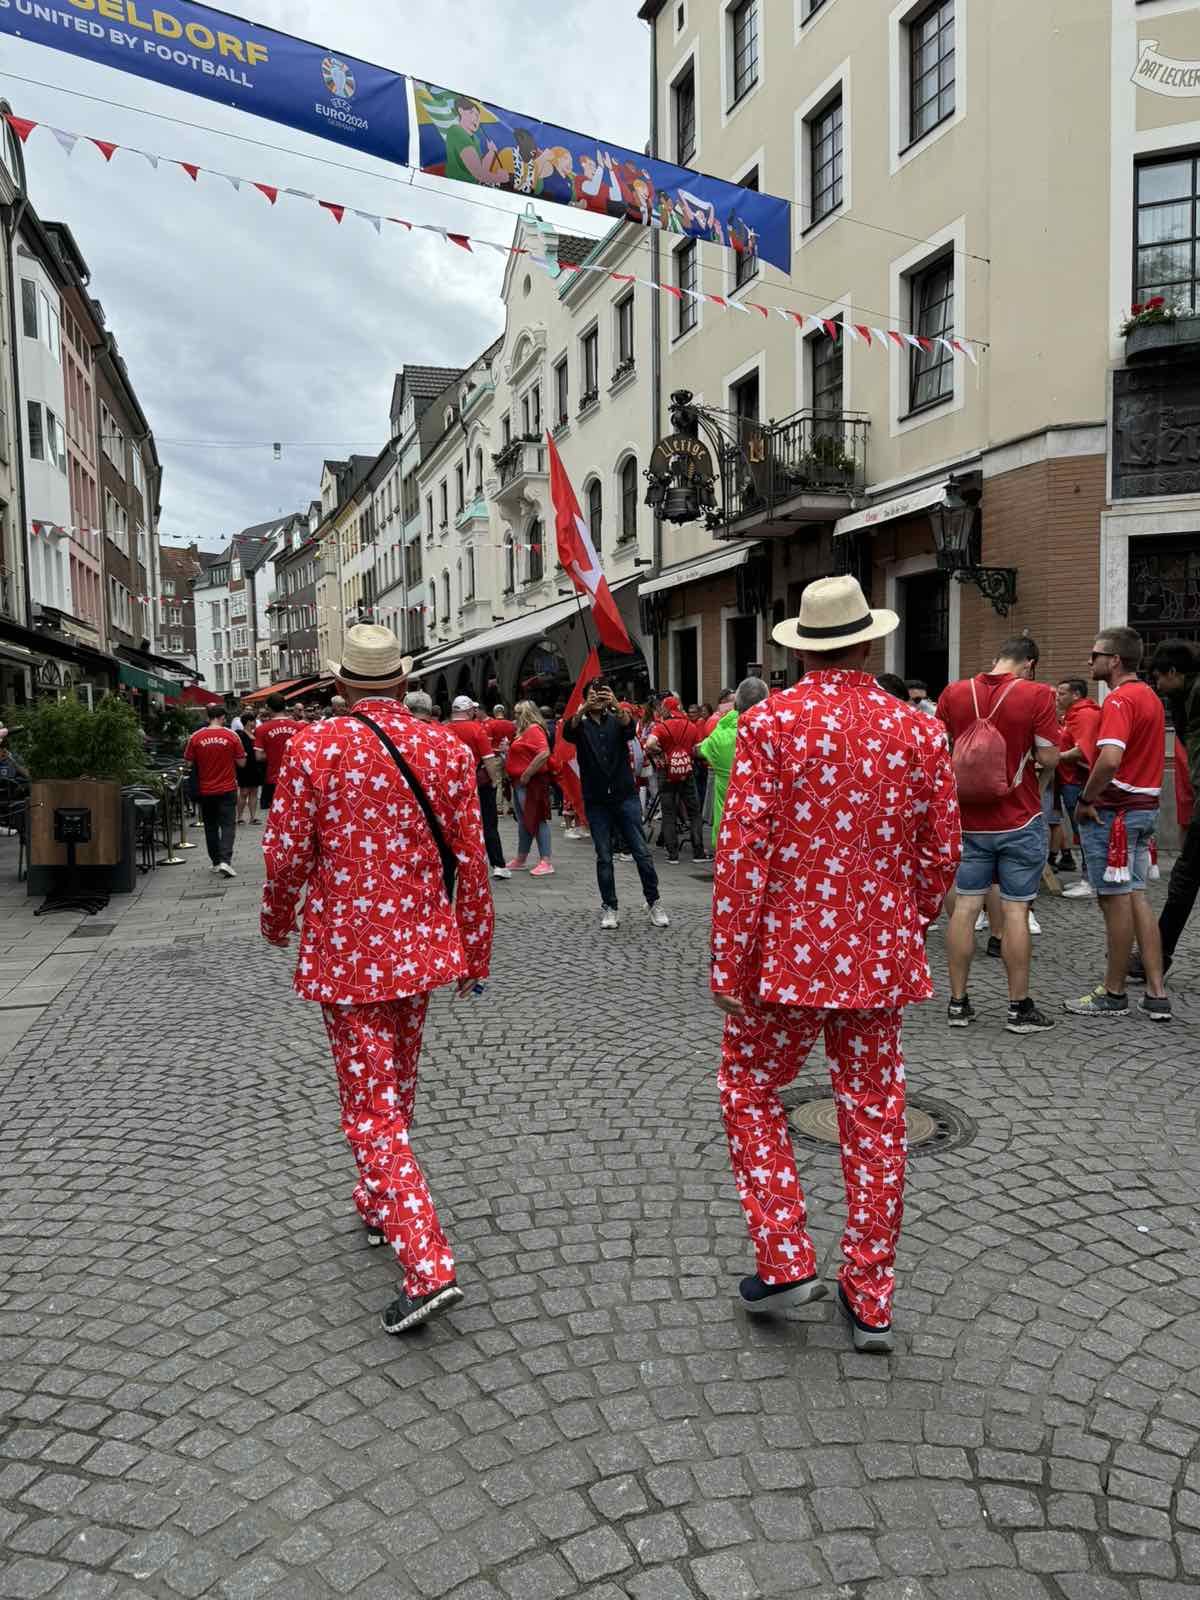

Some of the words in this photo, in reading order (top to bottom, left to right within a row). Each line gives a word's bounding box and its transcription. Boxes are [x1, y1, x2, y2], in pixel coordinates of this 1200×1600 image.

[16, 0, 105, 38] UNITED
[110, 28, 138, 48] BY
[143, 40, 254, 88] FOOTBALL
[1139, 59, 1163, 79] DAT
[268, 727, 297, 738] SUISSE
[200, 736, 228, 747] SUISSE
